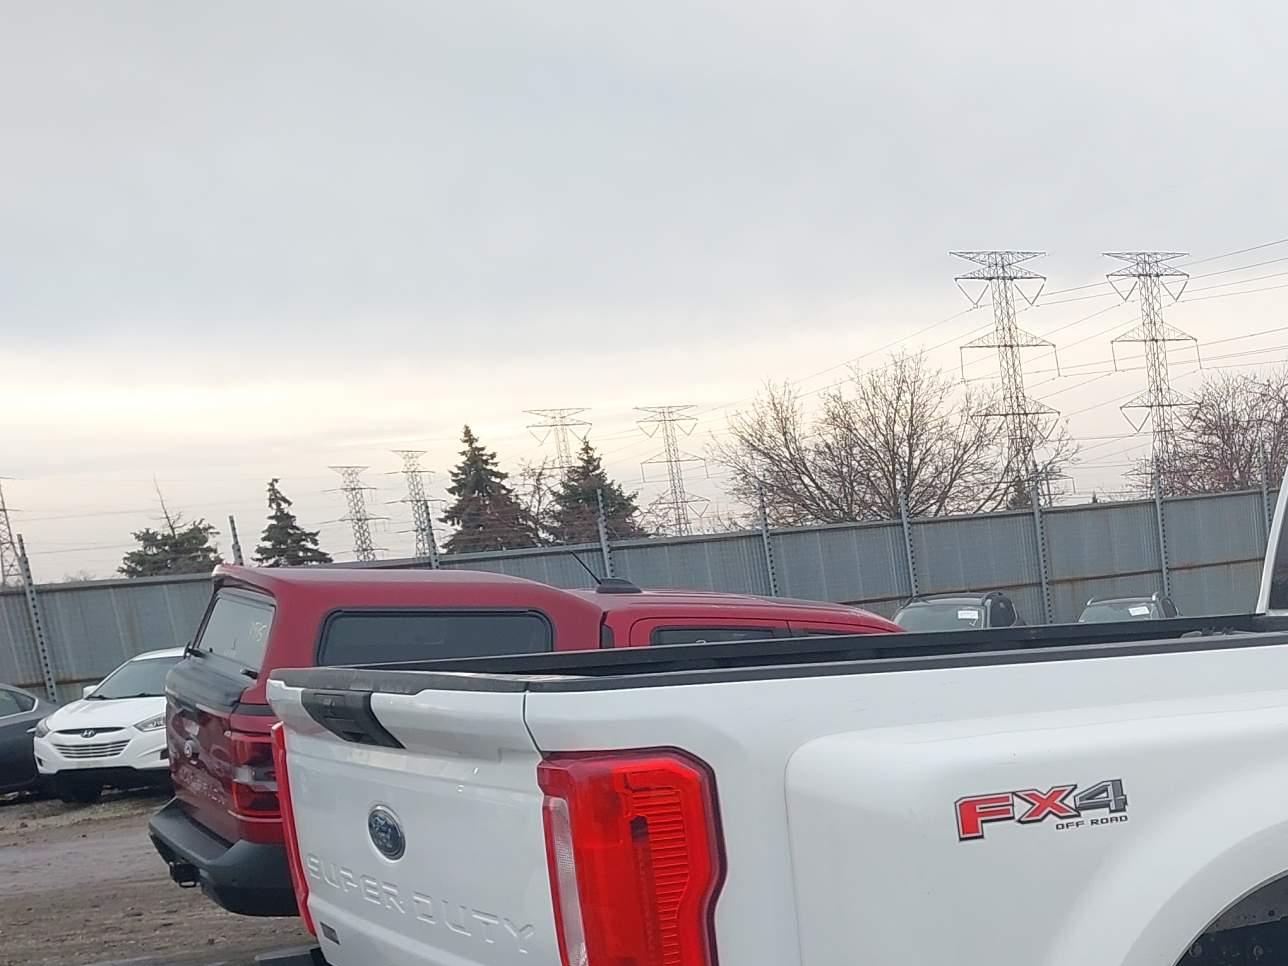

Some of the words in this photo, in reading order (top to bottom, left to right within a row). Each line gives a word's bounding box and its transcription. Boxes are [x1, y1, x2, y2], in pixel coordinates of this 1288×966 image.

[955, 779, 1128, 841] FX4
[1055, 822, 1084, 831] OFF
[1090, 815, 1129, 827] ROAD
[306, 855, 405, 914] SUPER
[412, 891, 535, 954] DUTY
